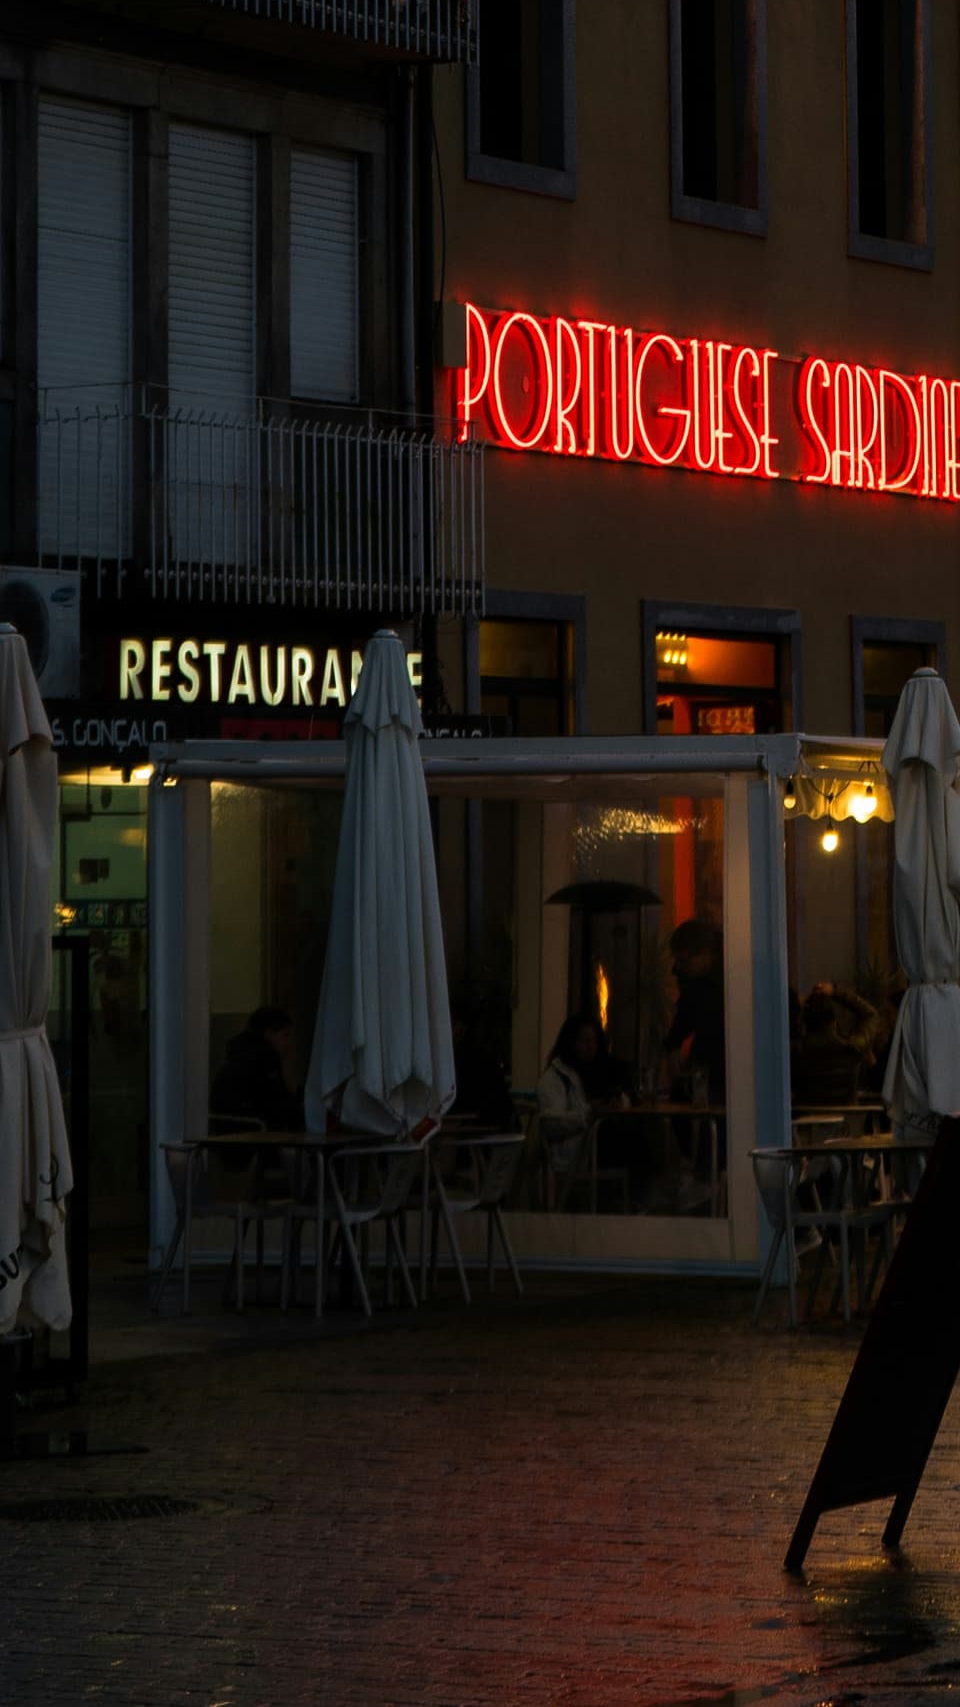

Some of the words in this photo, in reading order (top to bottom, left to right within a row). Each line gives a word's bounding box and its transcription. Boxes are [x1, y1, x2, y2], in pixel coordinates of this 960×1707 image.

[458, 301, 780, 477] PORTUGUESE
[119, 637, 424, 708] RESTAURANE
[72, 718, 168, 754] GONÇALO
